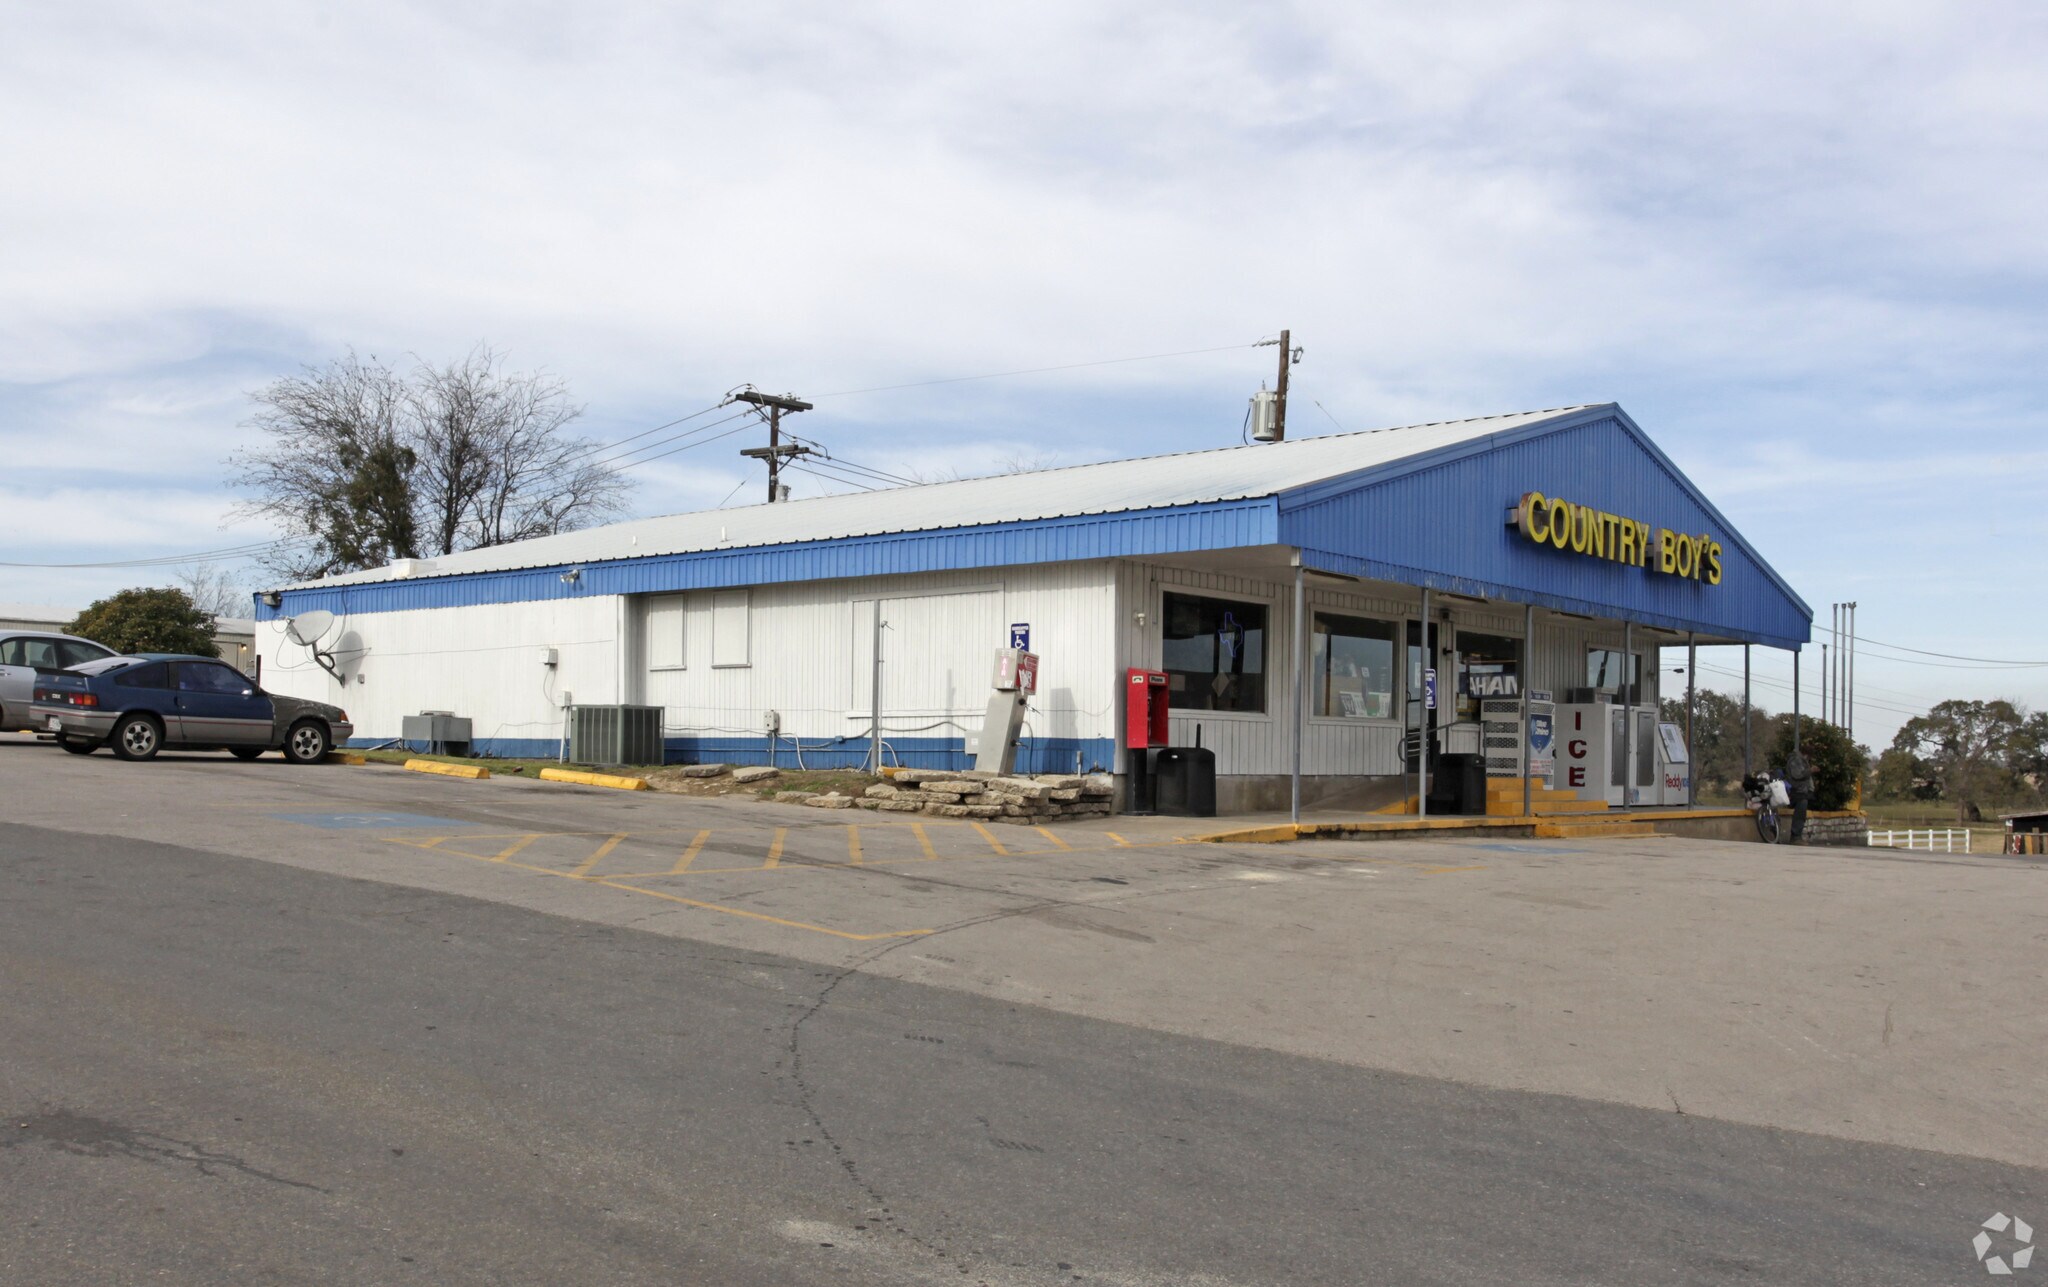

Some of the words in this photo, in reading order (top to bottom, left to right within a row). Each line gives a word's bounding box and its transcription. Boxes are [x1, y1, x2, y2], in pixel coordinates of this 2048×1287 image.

[1526, 491, 1650, 567] COUNTRY
[1661, 527, 1722, 585] BOY'S
[1568, 711, 1588, 787] ICE
